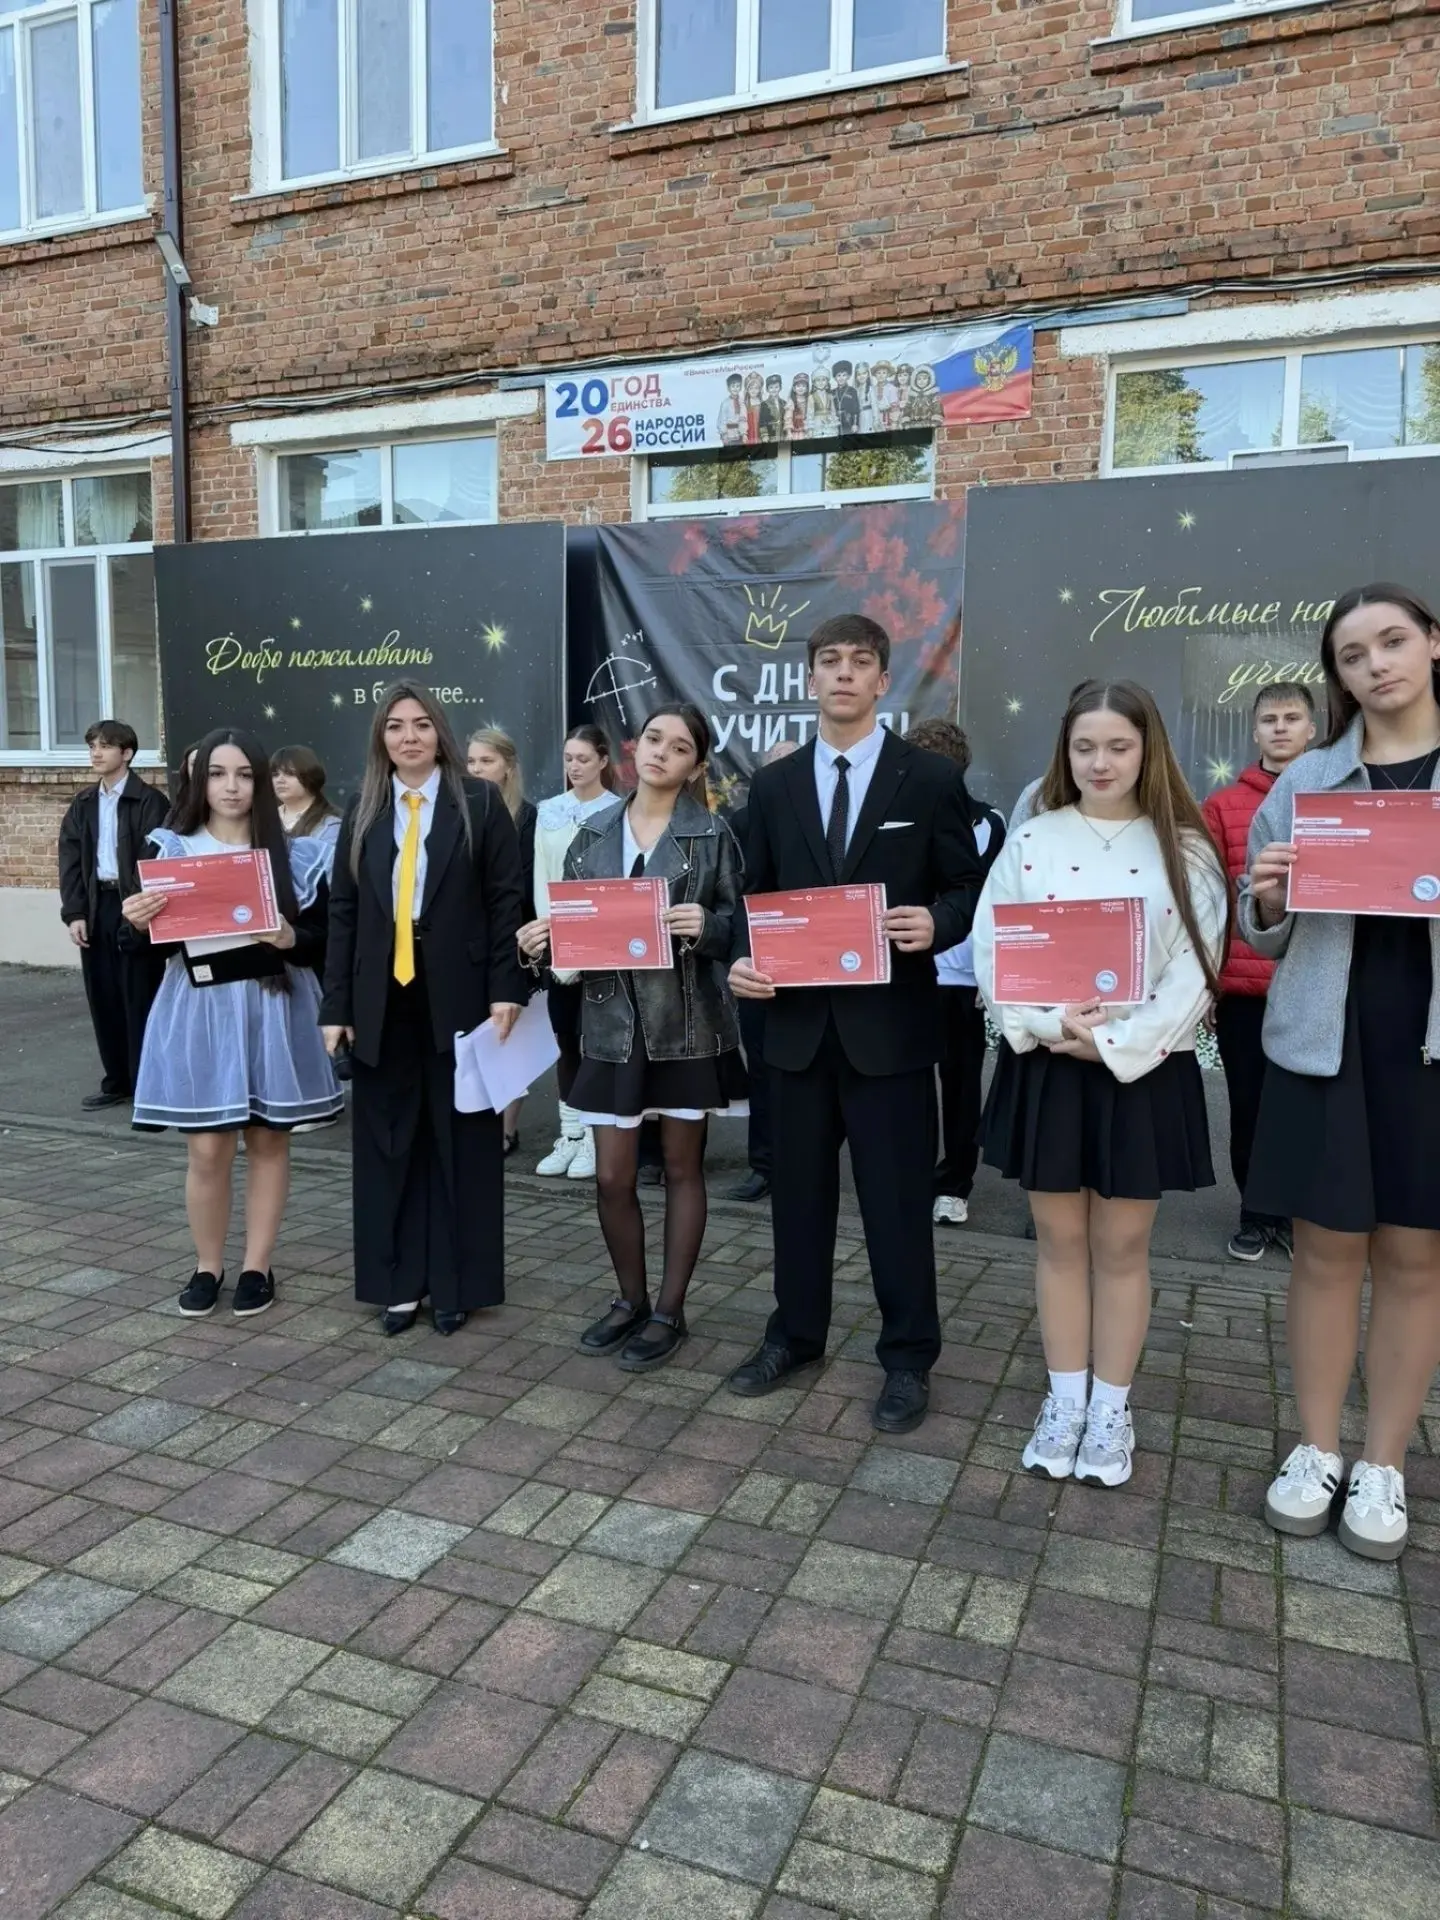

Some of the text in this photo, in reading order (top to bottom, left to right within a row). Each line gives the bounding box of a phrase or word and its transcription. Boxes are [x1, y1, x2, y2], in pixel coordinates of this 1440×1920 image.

[555, 379, 609, 418] 20
[610, 374, 661, 398] ГОД
[610, 398, 671, 412] ЕДИНСТВА
[581, 415, 633, 454] 26
[635, 414, 705, 431] НАРОДОВ
[635, 428, 705, 447] РОССИИ
[1090, 586, 1336, 642] Любимые на
[206, 630, 434, 684] Добро пожаловать
[353, 688, 366, 704] в
[712, 663, 818, 704] С ДН
